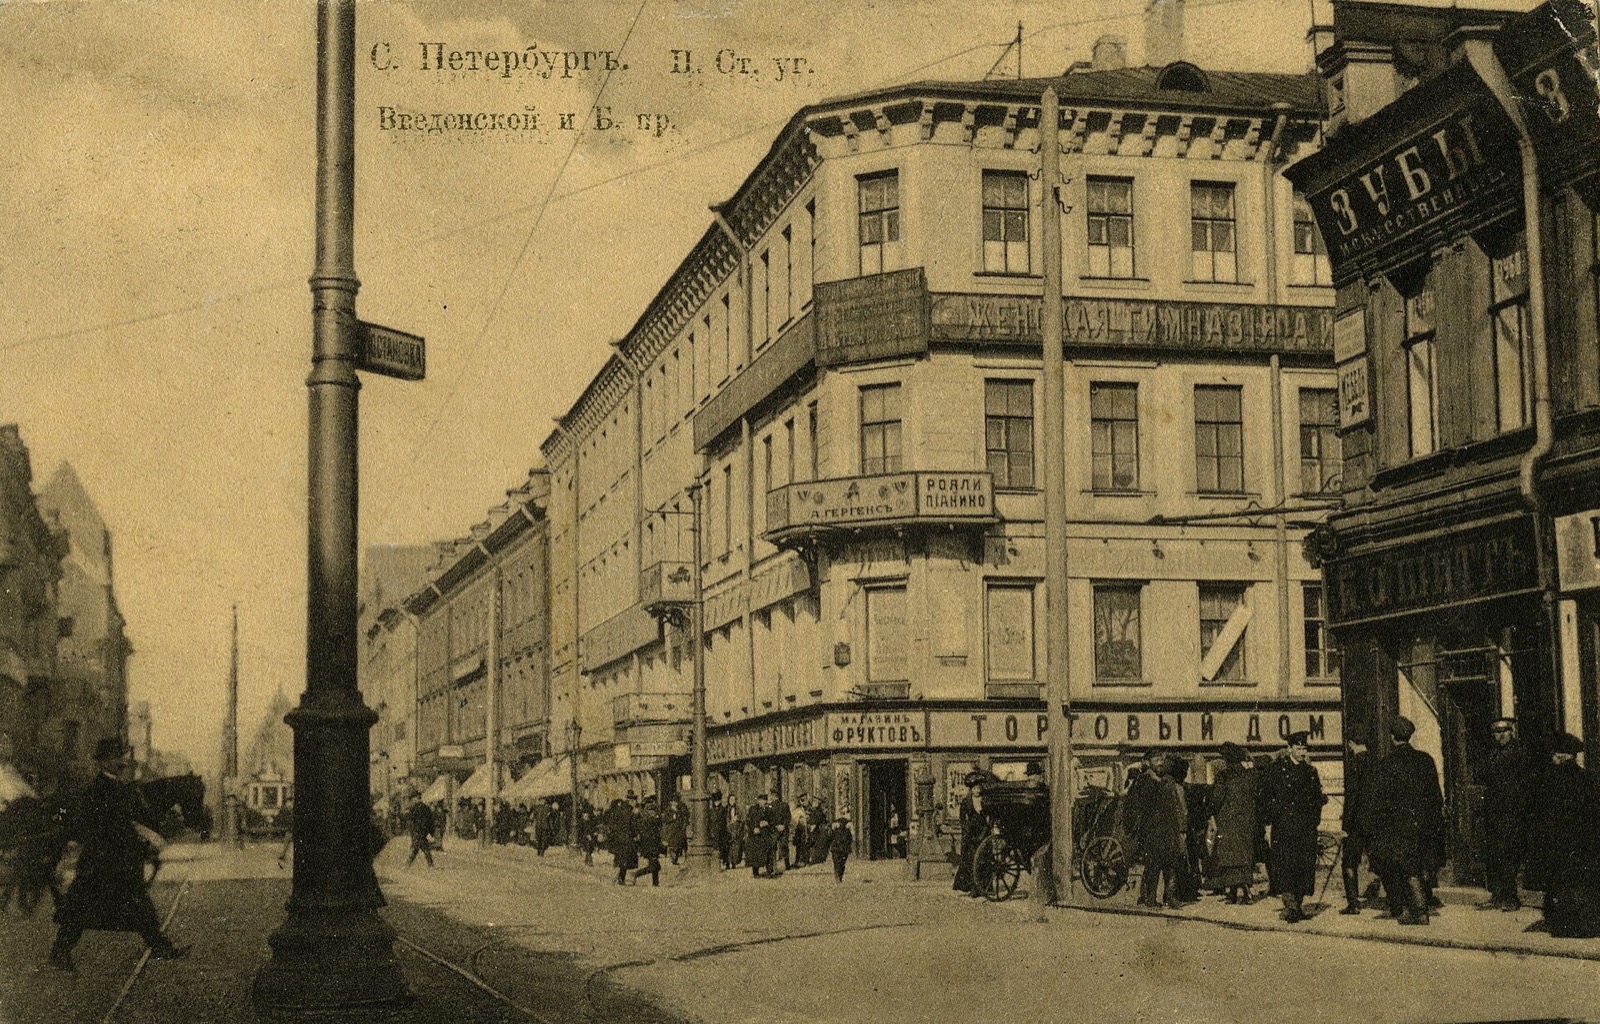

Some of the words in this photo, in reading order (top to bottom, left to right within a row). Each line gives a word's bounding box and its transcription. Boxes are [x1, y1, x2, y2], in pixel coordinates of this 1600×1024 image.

[1330, 113, 1486, 236] ЗУБЫ
[926, 478, 982, 492] РОЯЛИ
[925, 494, 986, 509] ПIАНИНО
[840, 714, 911, 725] МАГАЗИНЪ
[971, 711, 1216, 743] ТОРГОВЫЙ
